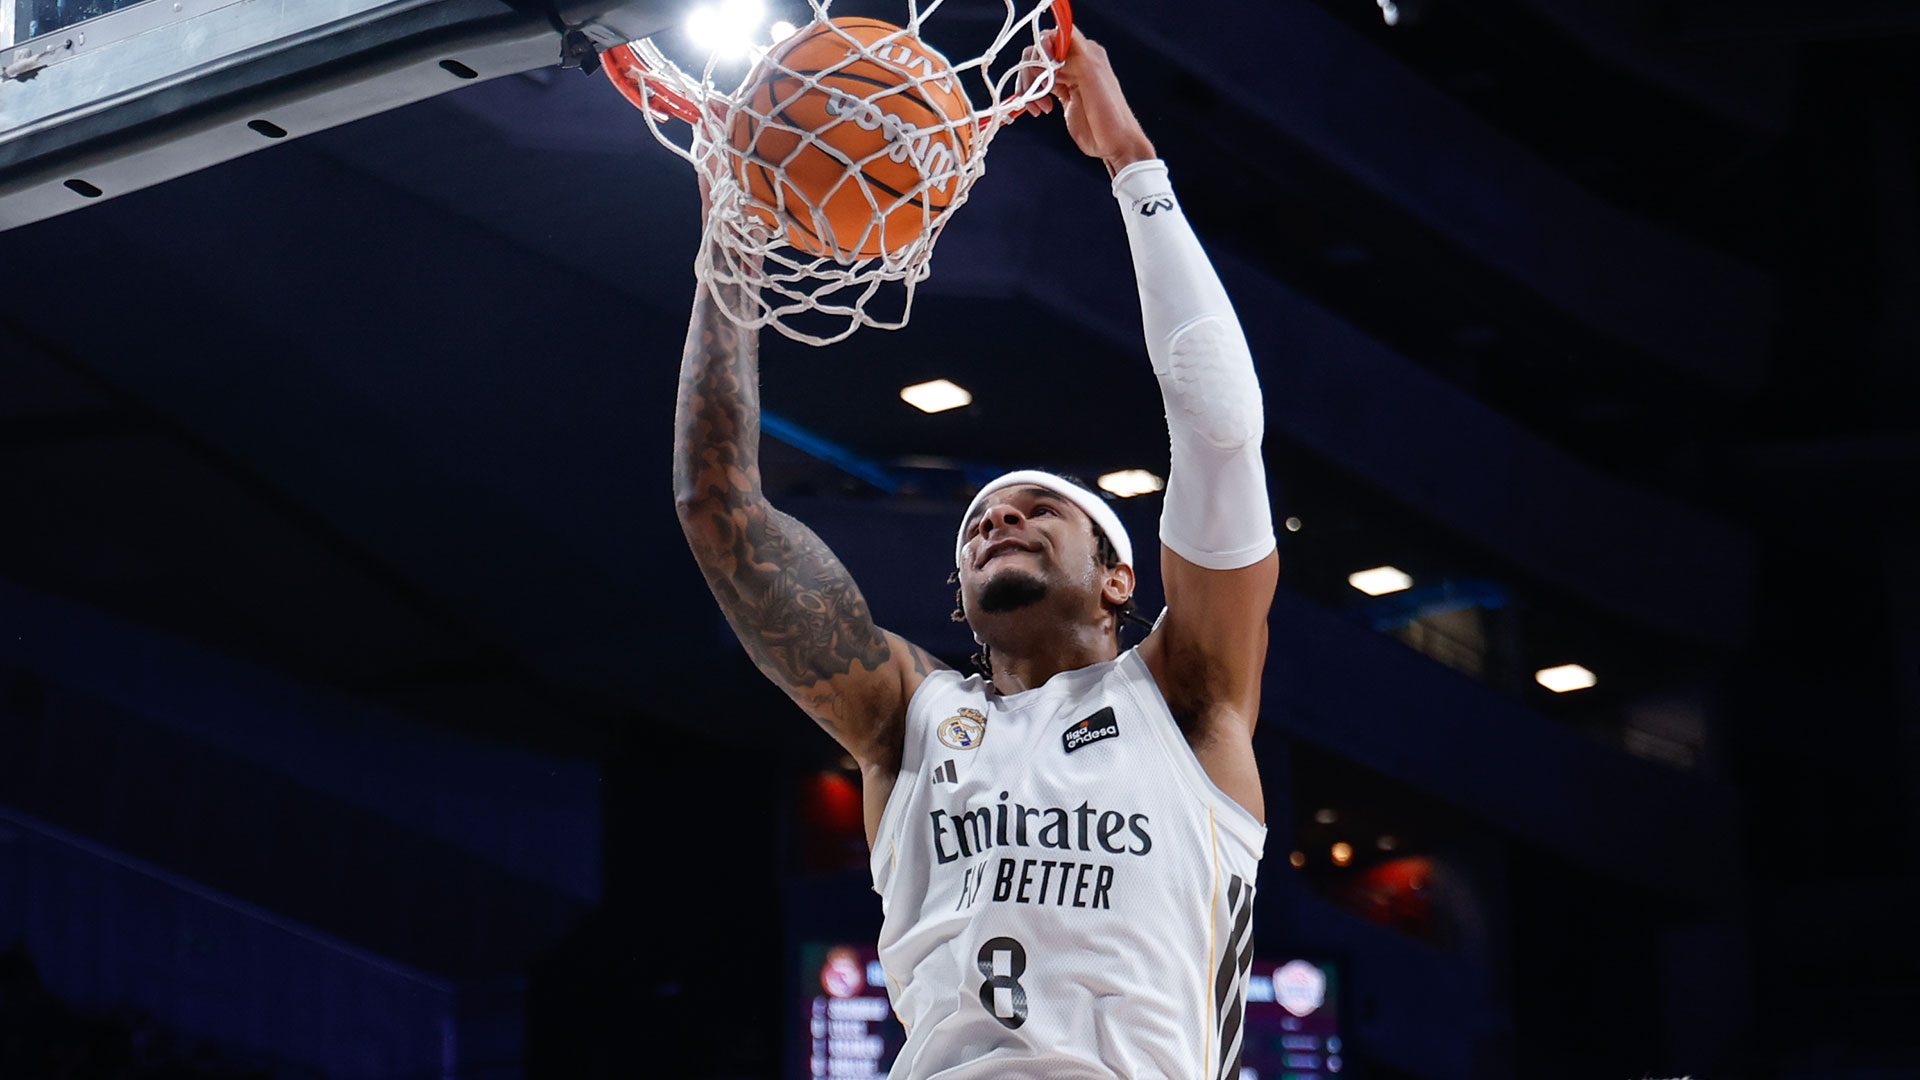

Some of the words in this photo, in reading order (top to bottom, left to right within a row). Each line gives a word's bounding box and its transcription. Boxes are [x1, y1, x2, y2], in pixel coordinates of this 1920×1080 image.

[825, 87, 955, 193] Wilson
[1065, 726, 1088, 741] liga
[1067, 725, 1117, 749] endesa
[929, 790, 1153, 865] Emirates
[992, 857, 1114, 909] BETTER
[977, 936, 1028, 1030] 8
